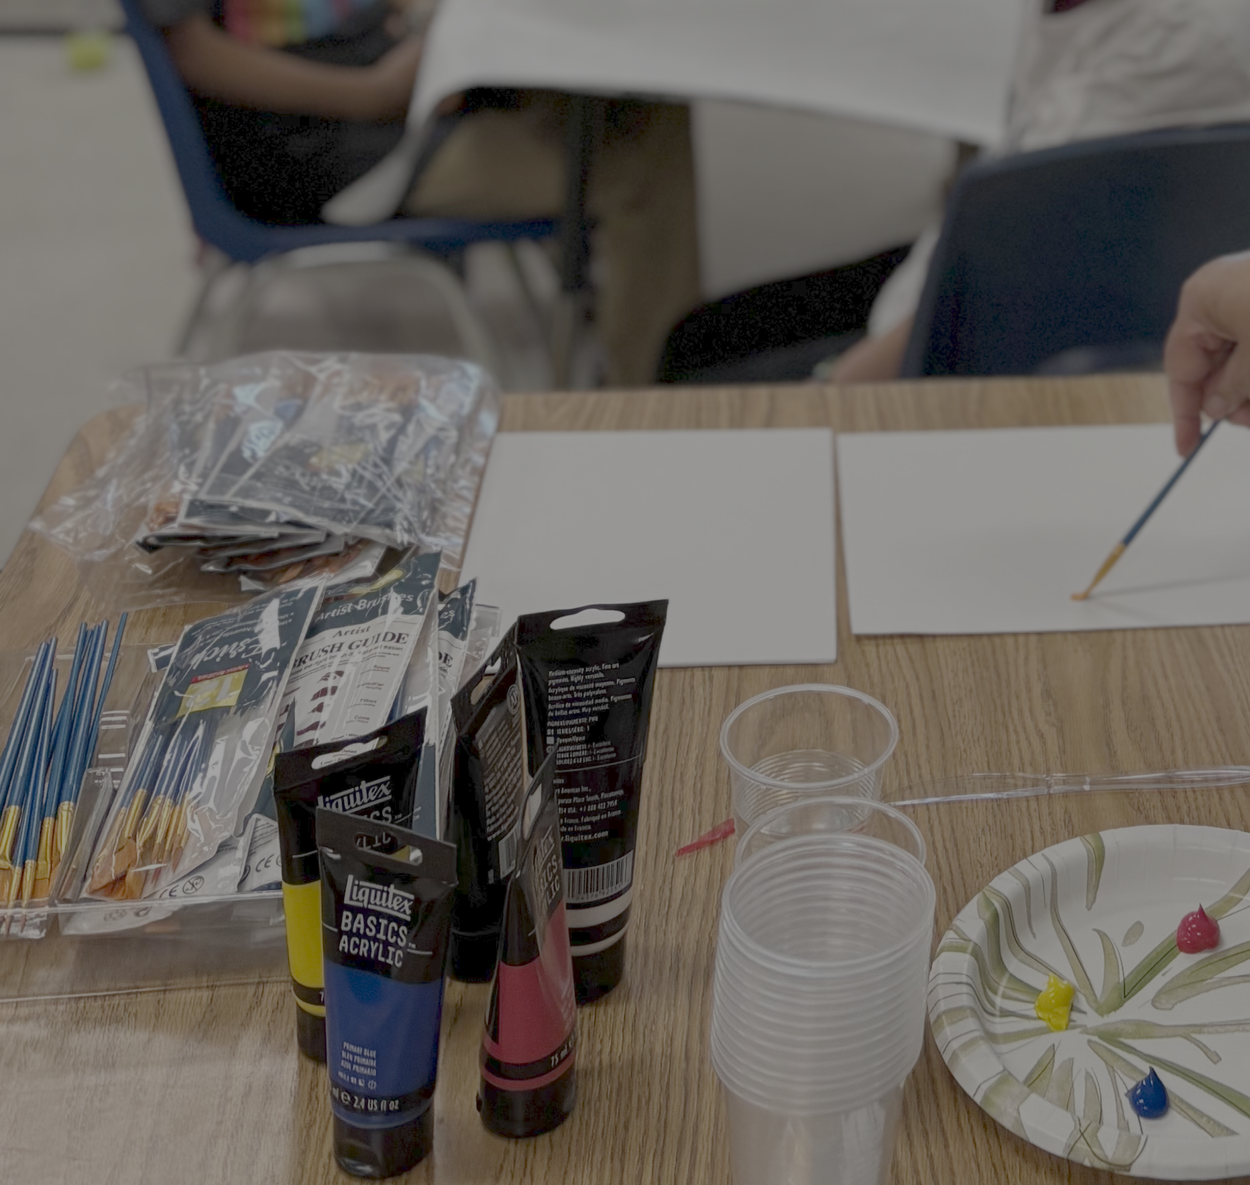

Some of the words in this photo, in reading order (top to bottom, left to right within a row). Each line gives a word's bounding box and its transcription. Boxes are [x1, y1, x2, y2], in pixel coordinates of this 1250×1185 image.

[315, 603, 353, 622] Artist
[356, 592, 414, 612] Bruses
[331, 626, 371, 639] Artist
[348, 631, 409, 650] GUIDE
[344, 874, 415, 922] Liquitex
[340, 910, 409, 948] BASICS
[338, 934, 404, 968] ACRYLIC
[367, 1097, 378, 1111] US
